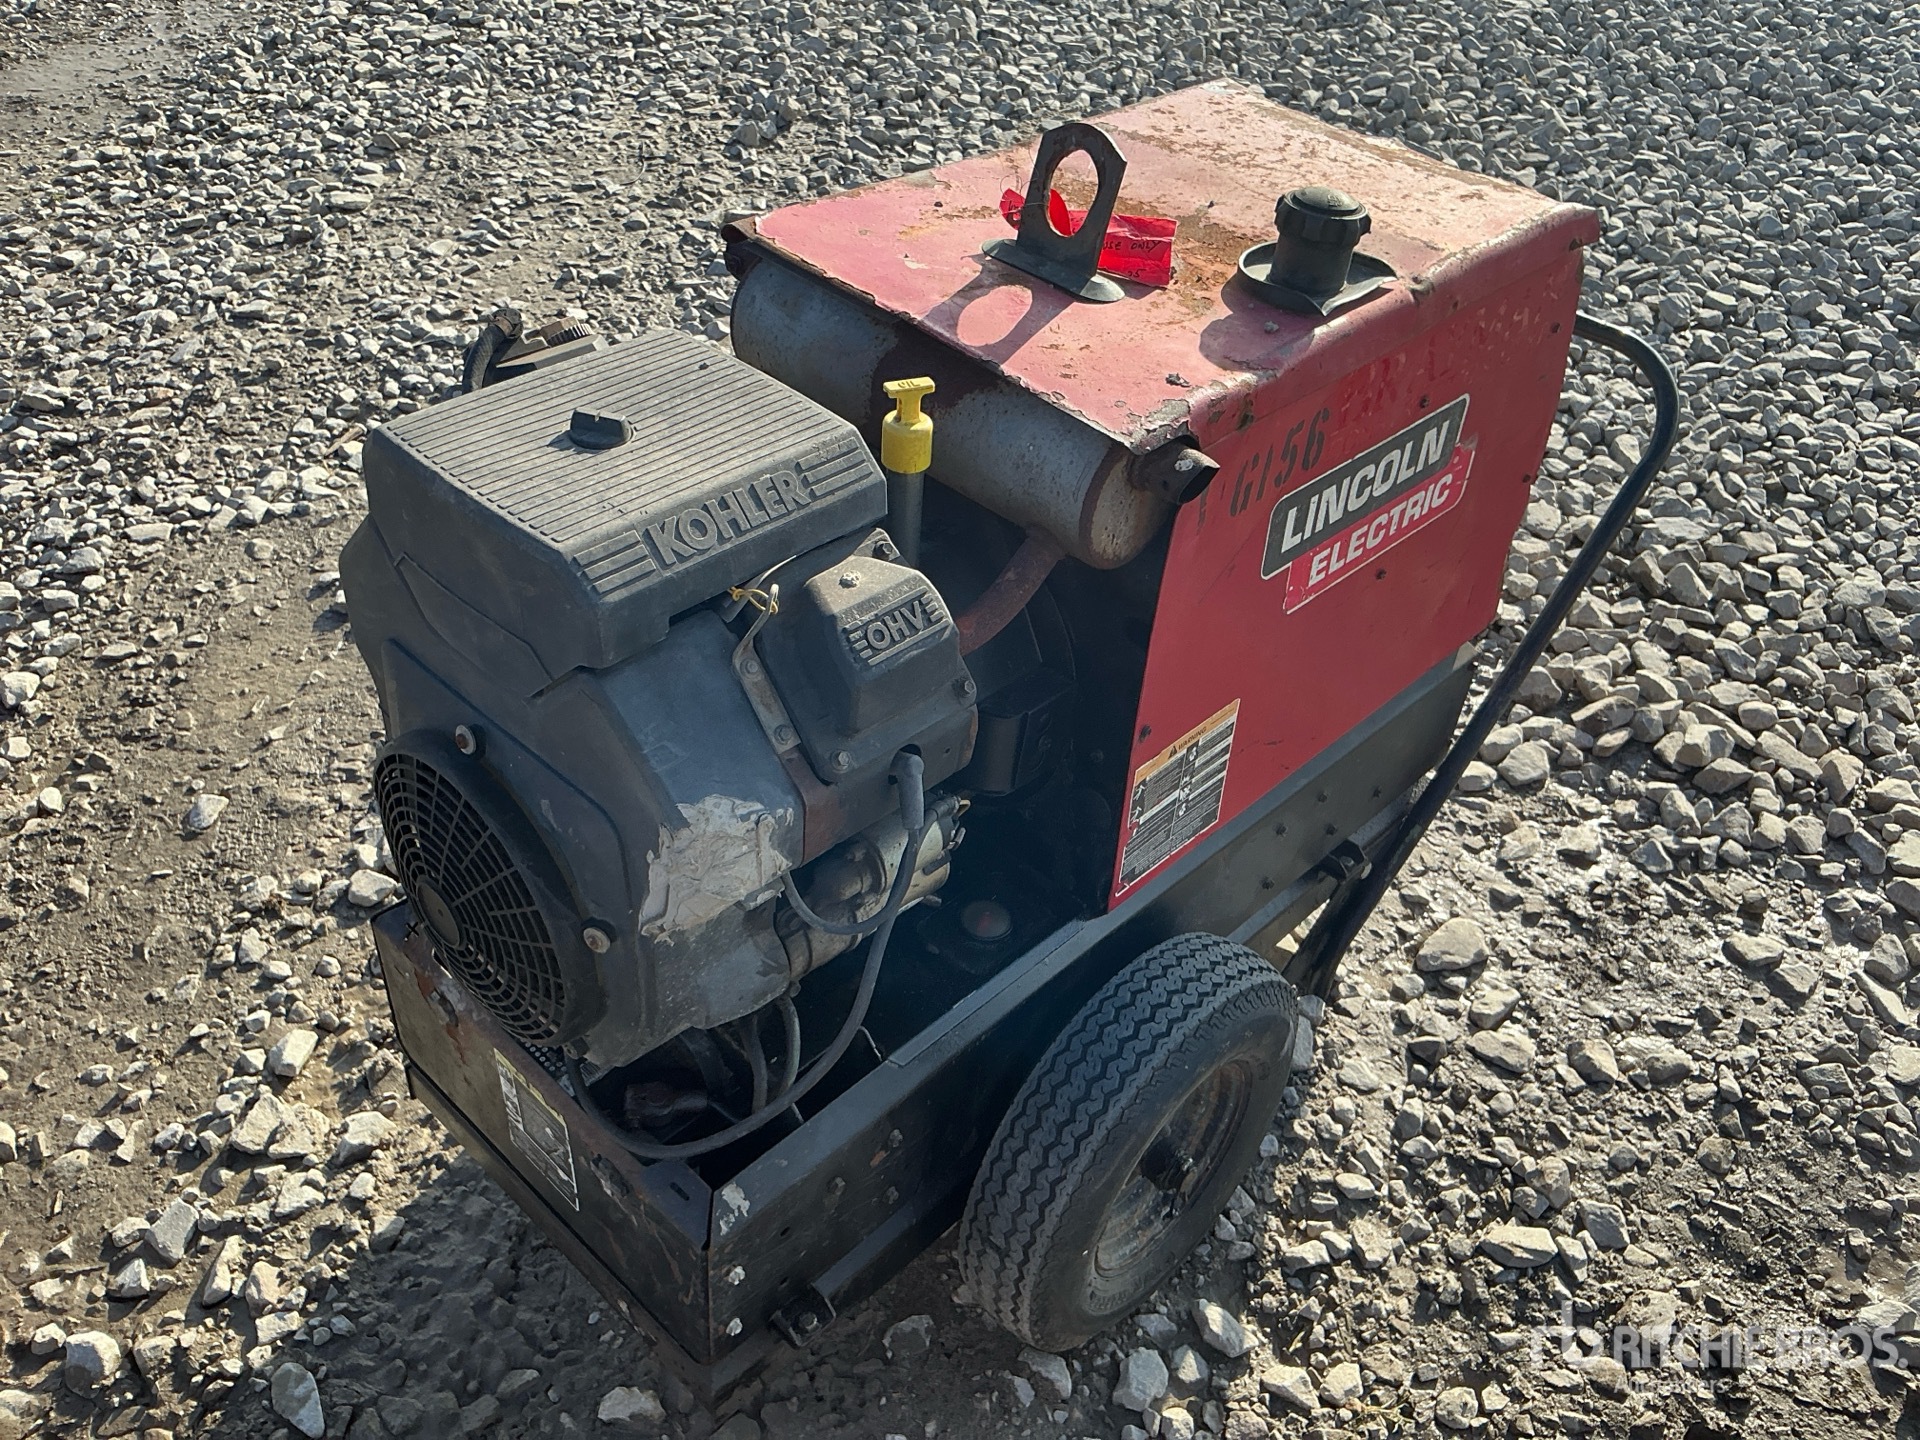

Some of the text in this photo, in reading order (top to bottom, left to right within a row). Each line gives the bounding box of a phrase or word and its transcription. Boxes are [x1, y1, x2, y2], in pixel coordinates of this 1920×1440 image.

[1131, 239, 1161, 253] ONLY
[897, 380, 920, 388] OIL
[646, 468, 811, 566] KOHLER
[1281, 420, 1449, 553] LINCOLN
[1308, 473, 1453, 587] ELECTRIC
[866, 600, 925, 650] OHV
